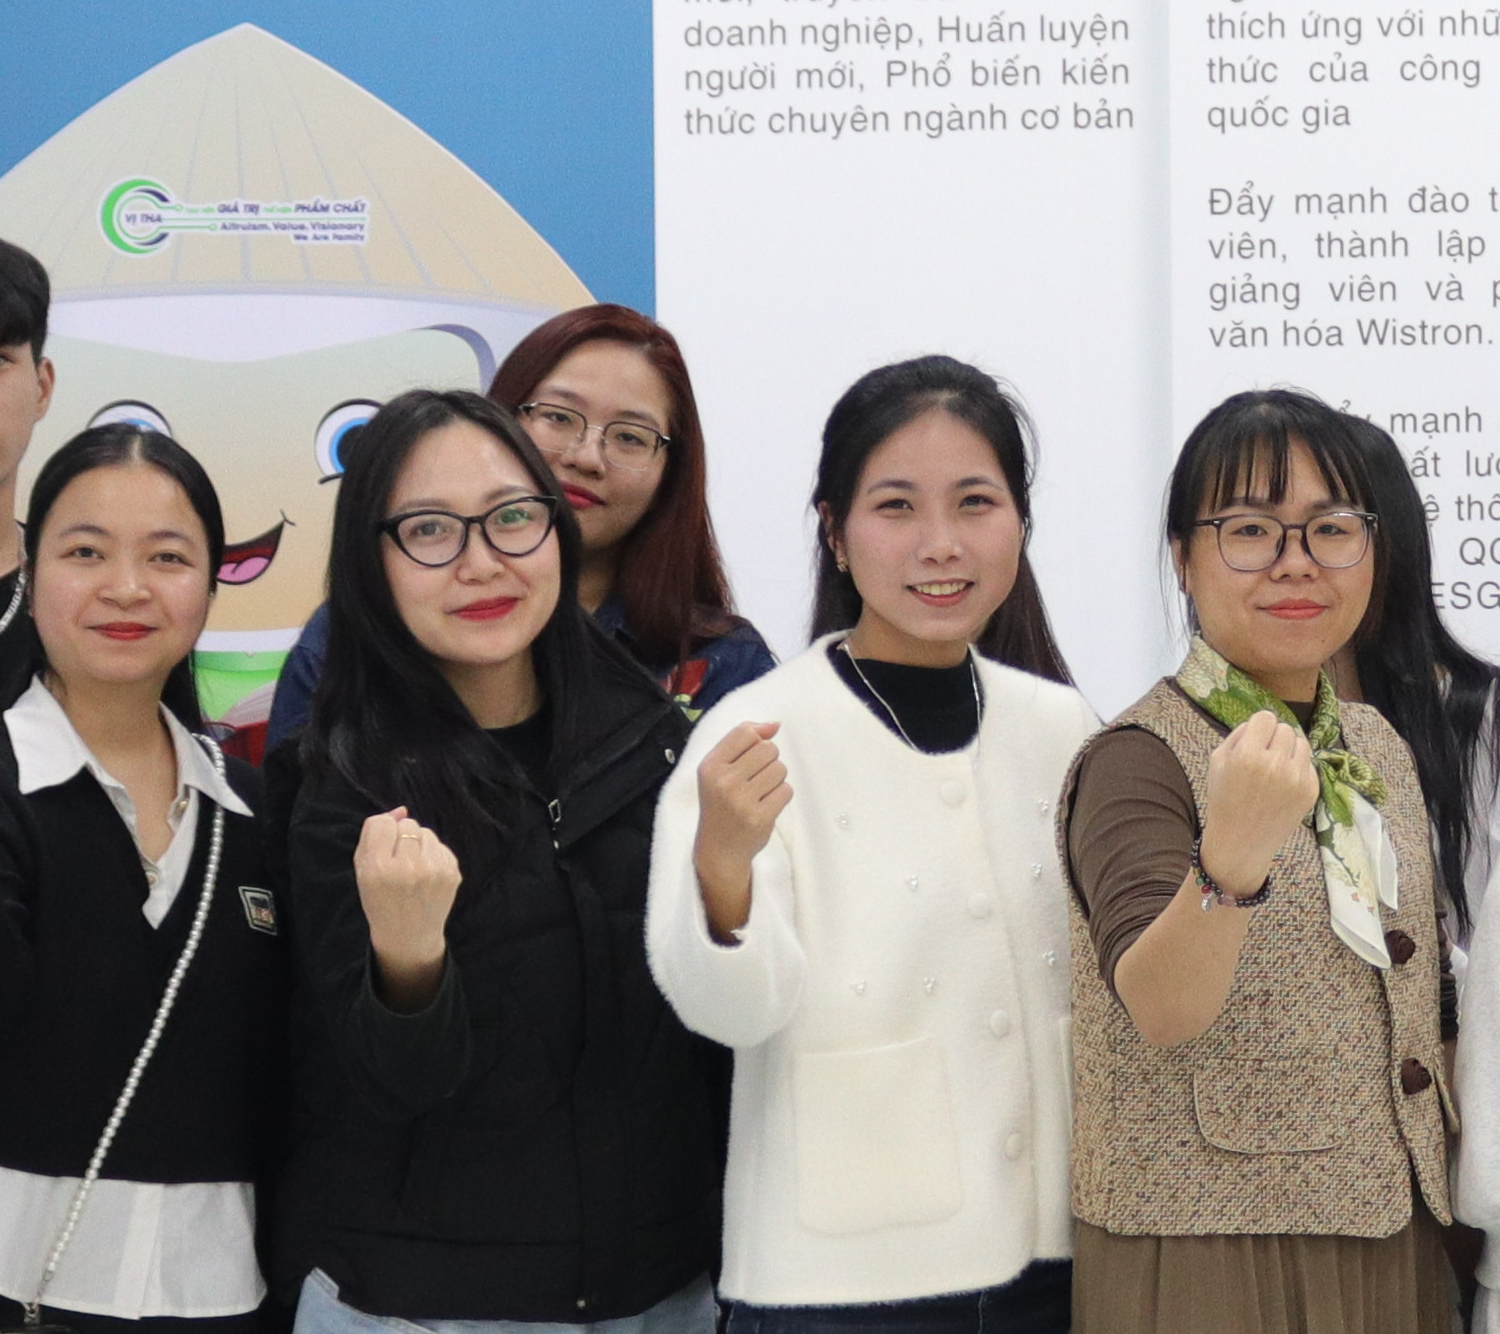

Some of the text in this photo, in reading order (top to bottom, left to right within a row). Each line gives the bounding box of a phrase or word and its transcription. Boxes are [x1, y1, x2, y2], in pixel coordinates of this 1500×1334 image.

[683, 10, 1129, 53] doanh nghiệp, Huấn luyện
[1206, 11, 1286, 40] thích
[1301, 10, 1363, 47] ứng
[1376, 9, 1424, 38] với
[684, 97, 1134, 141] thức chuyên ngành cơ bản
[1207, 179, 1275, 223] Đẩy
[1294, 186, 1388, 221] mạnh
[1407, 184, 1470, 214] đào
[1208, 317, 1494, 349] văn hóa Wistron.
[1389, 406, 1483, 439] mạnh
